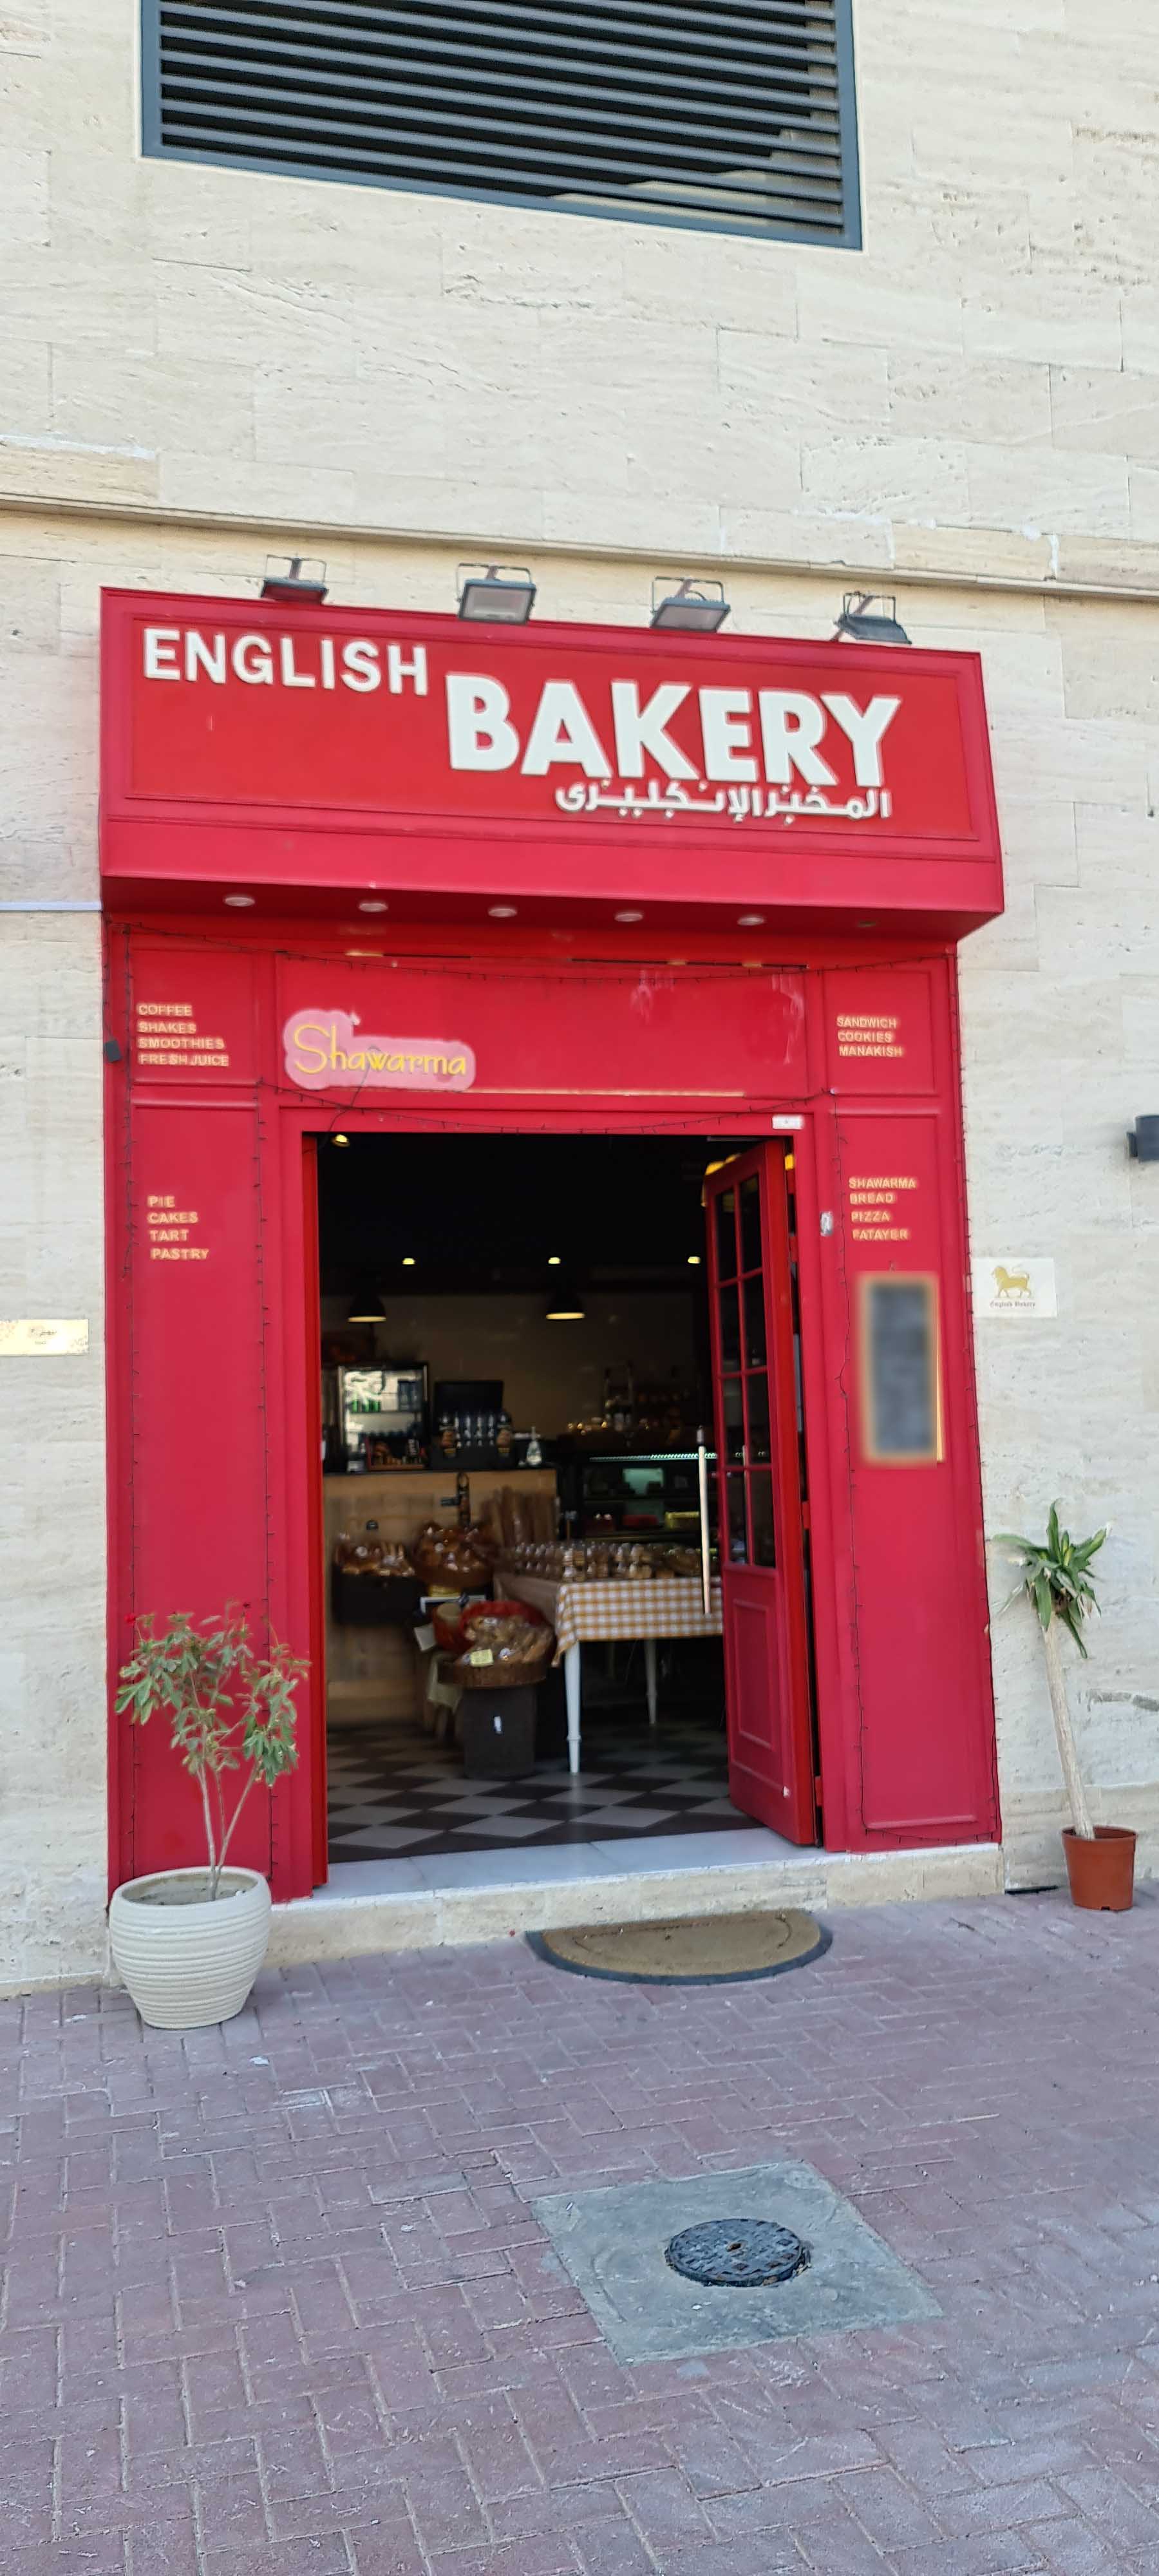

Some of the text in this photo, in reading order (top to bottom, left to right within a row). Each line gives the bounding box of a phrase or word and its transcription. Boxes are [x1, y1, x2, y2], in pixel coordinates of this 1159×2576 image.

[143, 627, 428, 696] ENGLISH
[445, 673, 901, 787] BAKERY
[137, 1003, 192, 1016] COFFEE
[138, 1021, 196, 1034] SHAKES
[837, 1015, 898, 1029] SANDWICH
[838, 1030, 894, 1043] COOKIES
[138, 1037, 225, 1050] SMOOTHIES
[293, 1024, 467, 1075] Shawarma
[839, 1045, 903, 1057] MANAKISH
[138, 1053, 229, 1066] FRESH JUICE
[849, 1177, 917, 1189] SHAWARMA
[147, 1195, 175, 1208] PIE
[850, 1192, 895, 1205] BREAD
[147, 1211, 198, 1224] CAKES
[851, 1210, 890, 1223] PIZZA
[149, 1229, 189, 1242] TART
[853, 1228, 909, 1240] FATAYER
[151, 1247, 209, 1260] PASTRY
